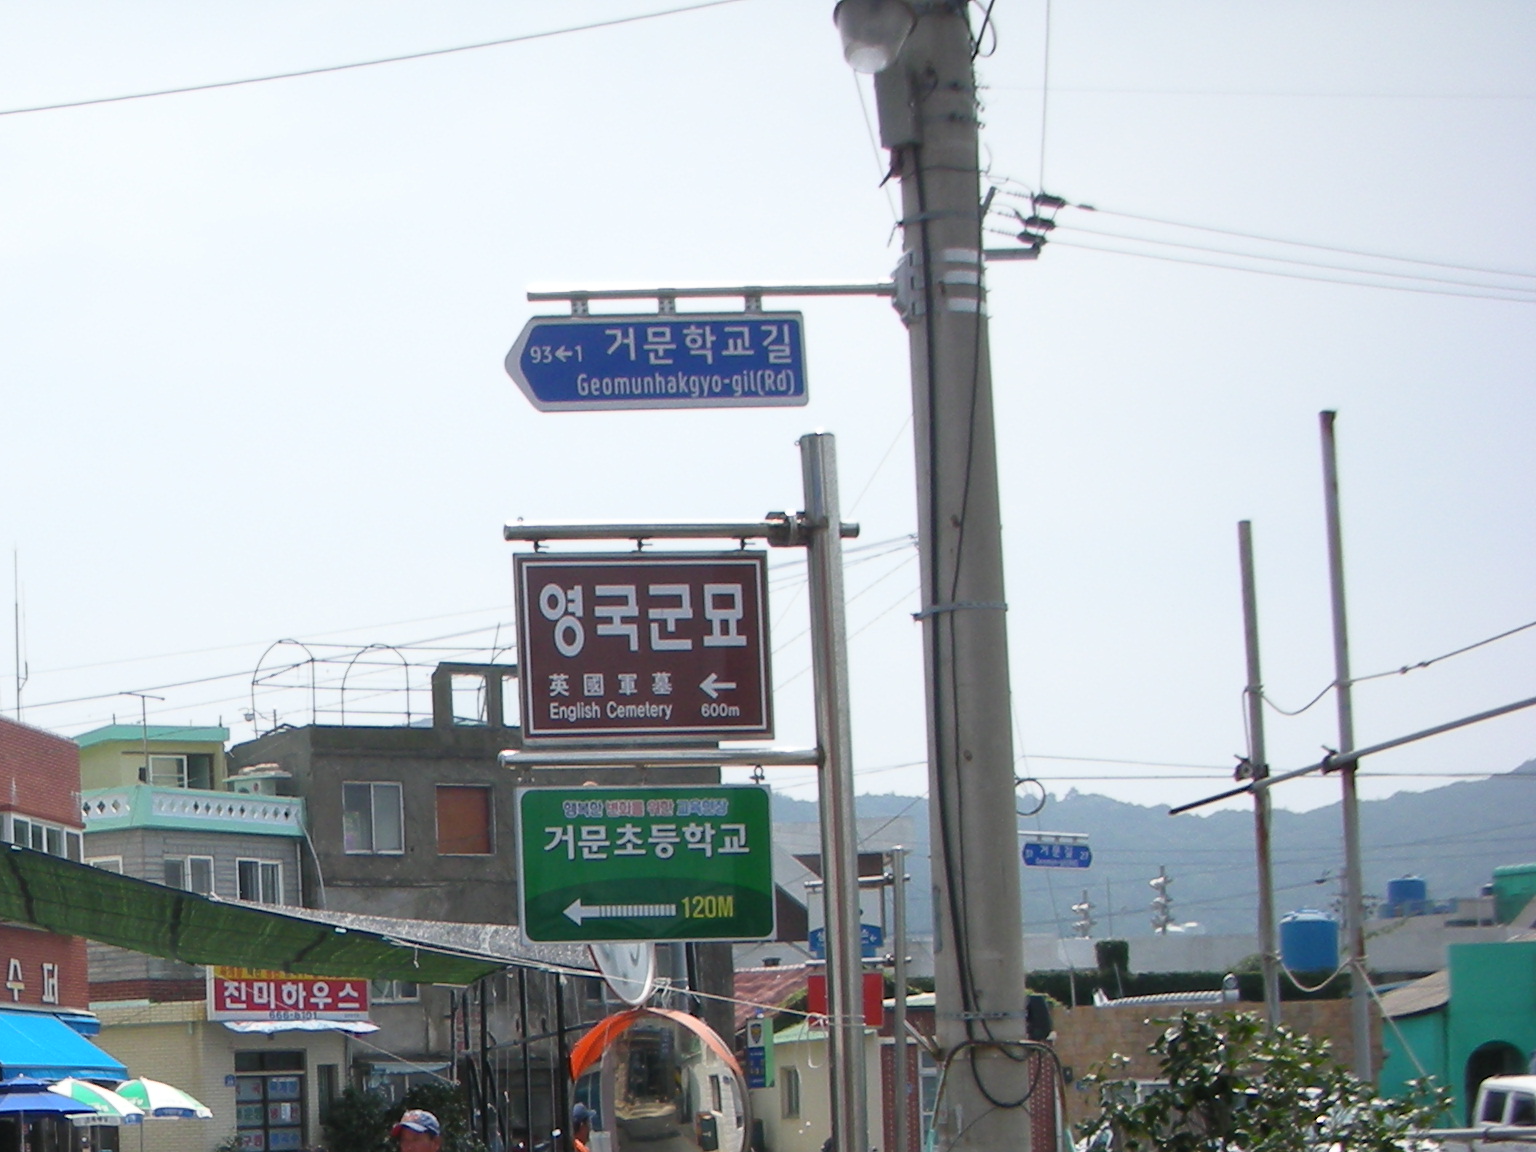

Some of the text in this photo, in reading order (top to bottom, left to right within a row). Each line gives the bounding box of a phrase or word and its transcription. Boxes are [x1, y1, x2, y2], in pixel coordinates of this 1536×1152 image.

[530, 324, 793, 365] 93 1 거문학교길
[577, 370, 796, 398] Geomunhakgyo-gil(Rd)
[539, 583, 748, 657] 영국군묘
[549, 672, 673, 697] 英國軍墓
[549, 701, 673, 722] English Cemetery
[701, 703, 740, 718] 600m
[646, 799, 674, 816] 위한
[544, 823, 750, 860] 거문초등학교
[681, 896, 733, 918] 120M
[223, 981, 361, 1010] 진미하우스
